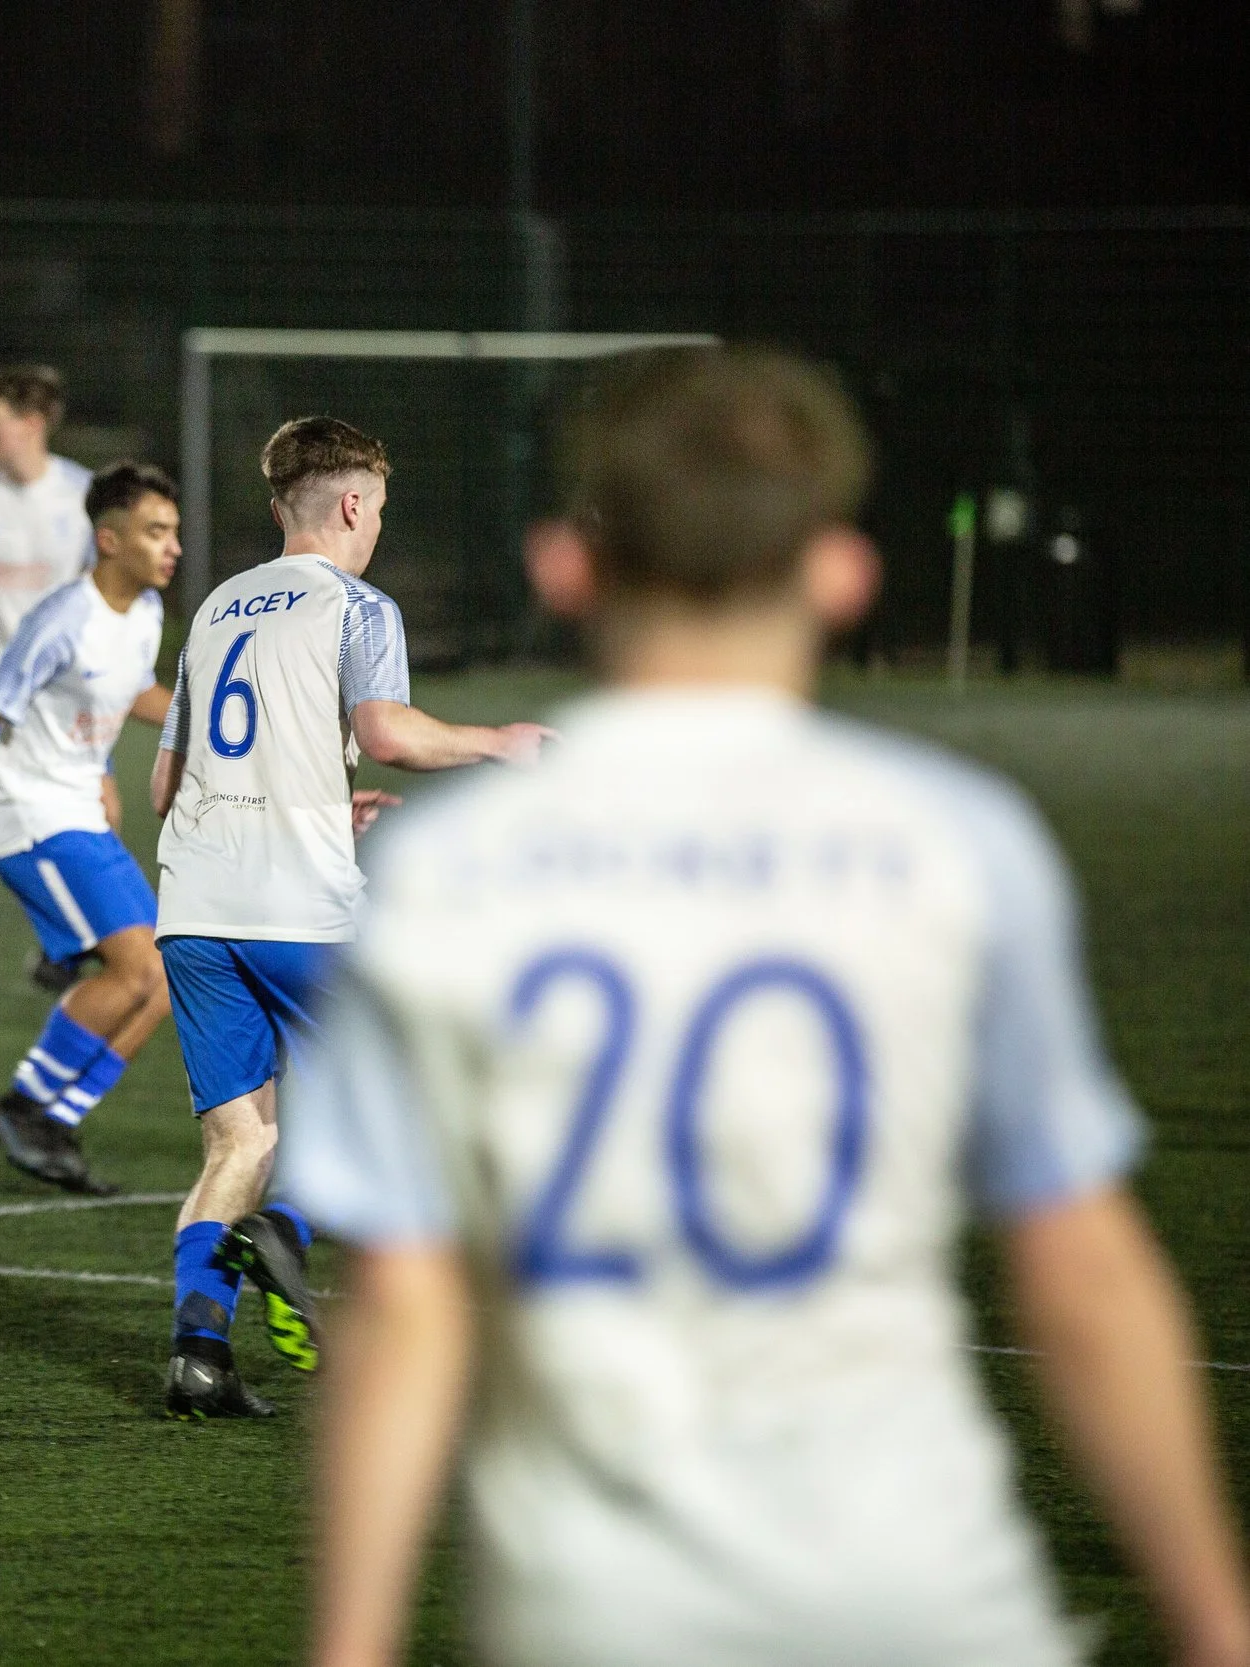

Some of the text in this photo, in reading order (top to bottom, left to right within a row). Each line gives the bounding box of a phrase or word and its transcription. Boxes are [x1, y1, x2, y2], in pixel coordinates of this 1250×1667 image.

[210, 591, 306, 625] LACEY
[209, 630, 258, 759] 6
[242, 796, 267, 805] FIRST
[506, 946, 868, 1294] 20
